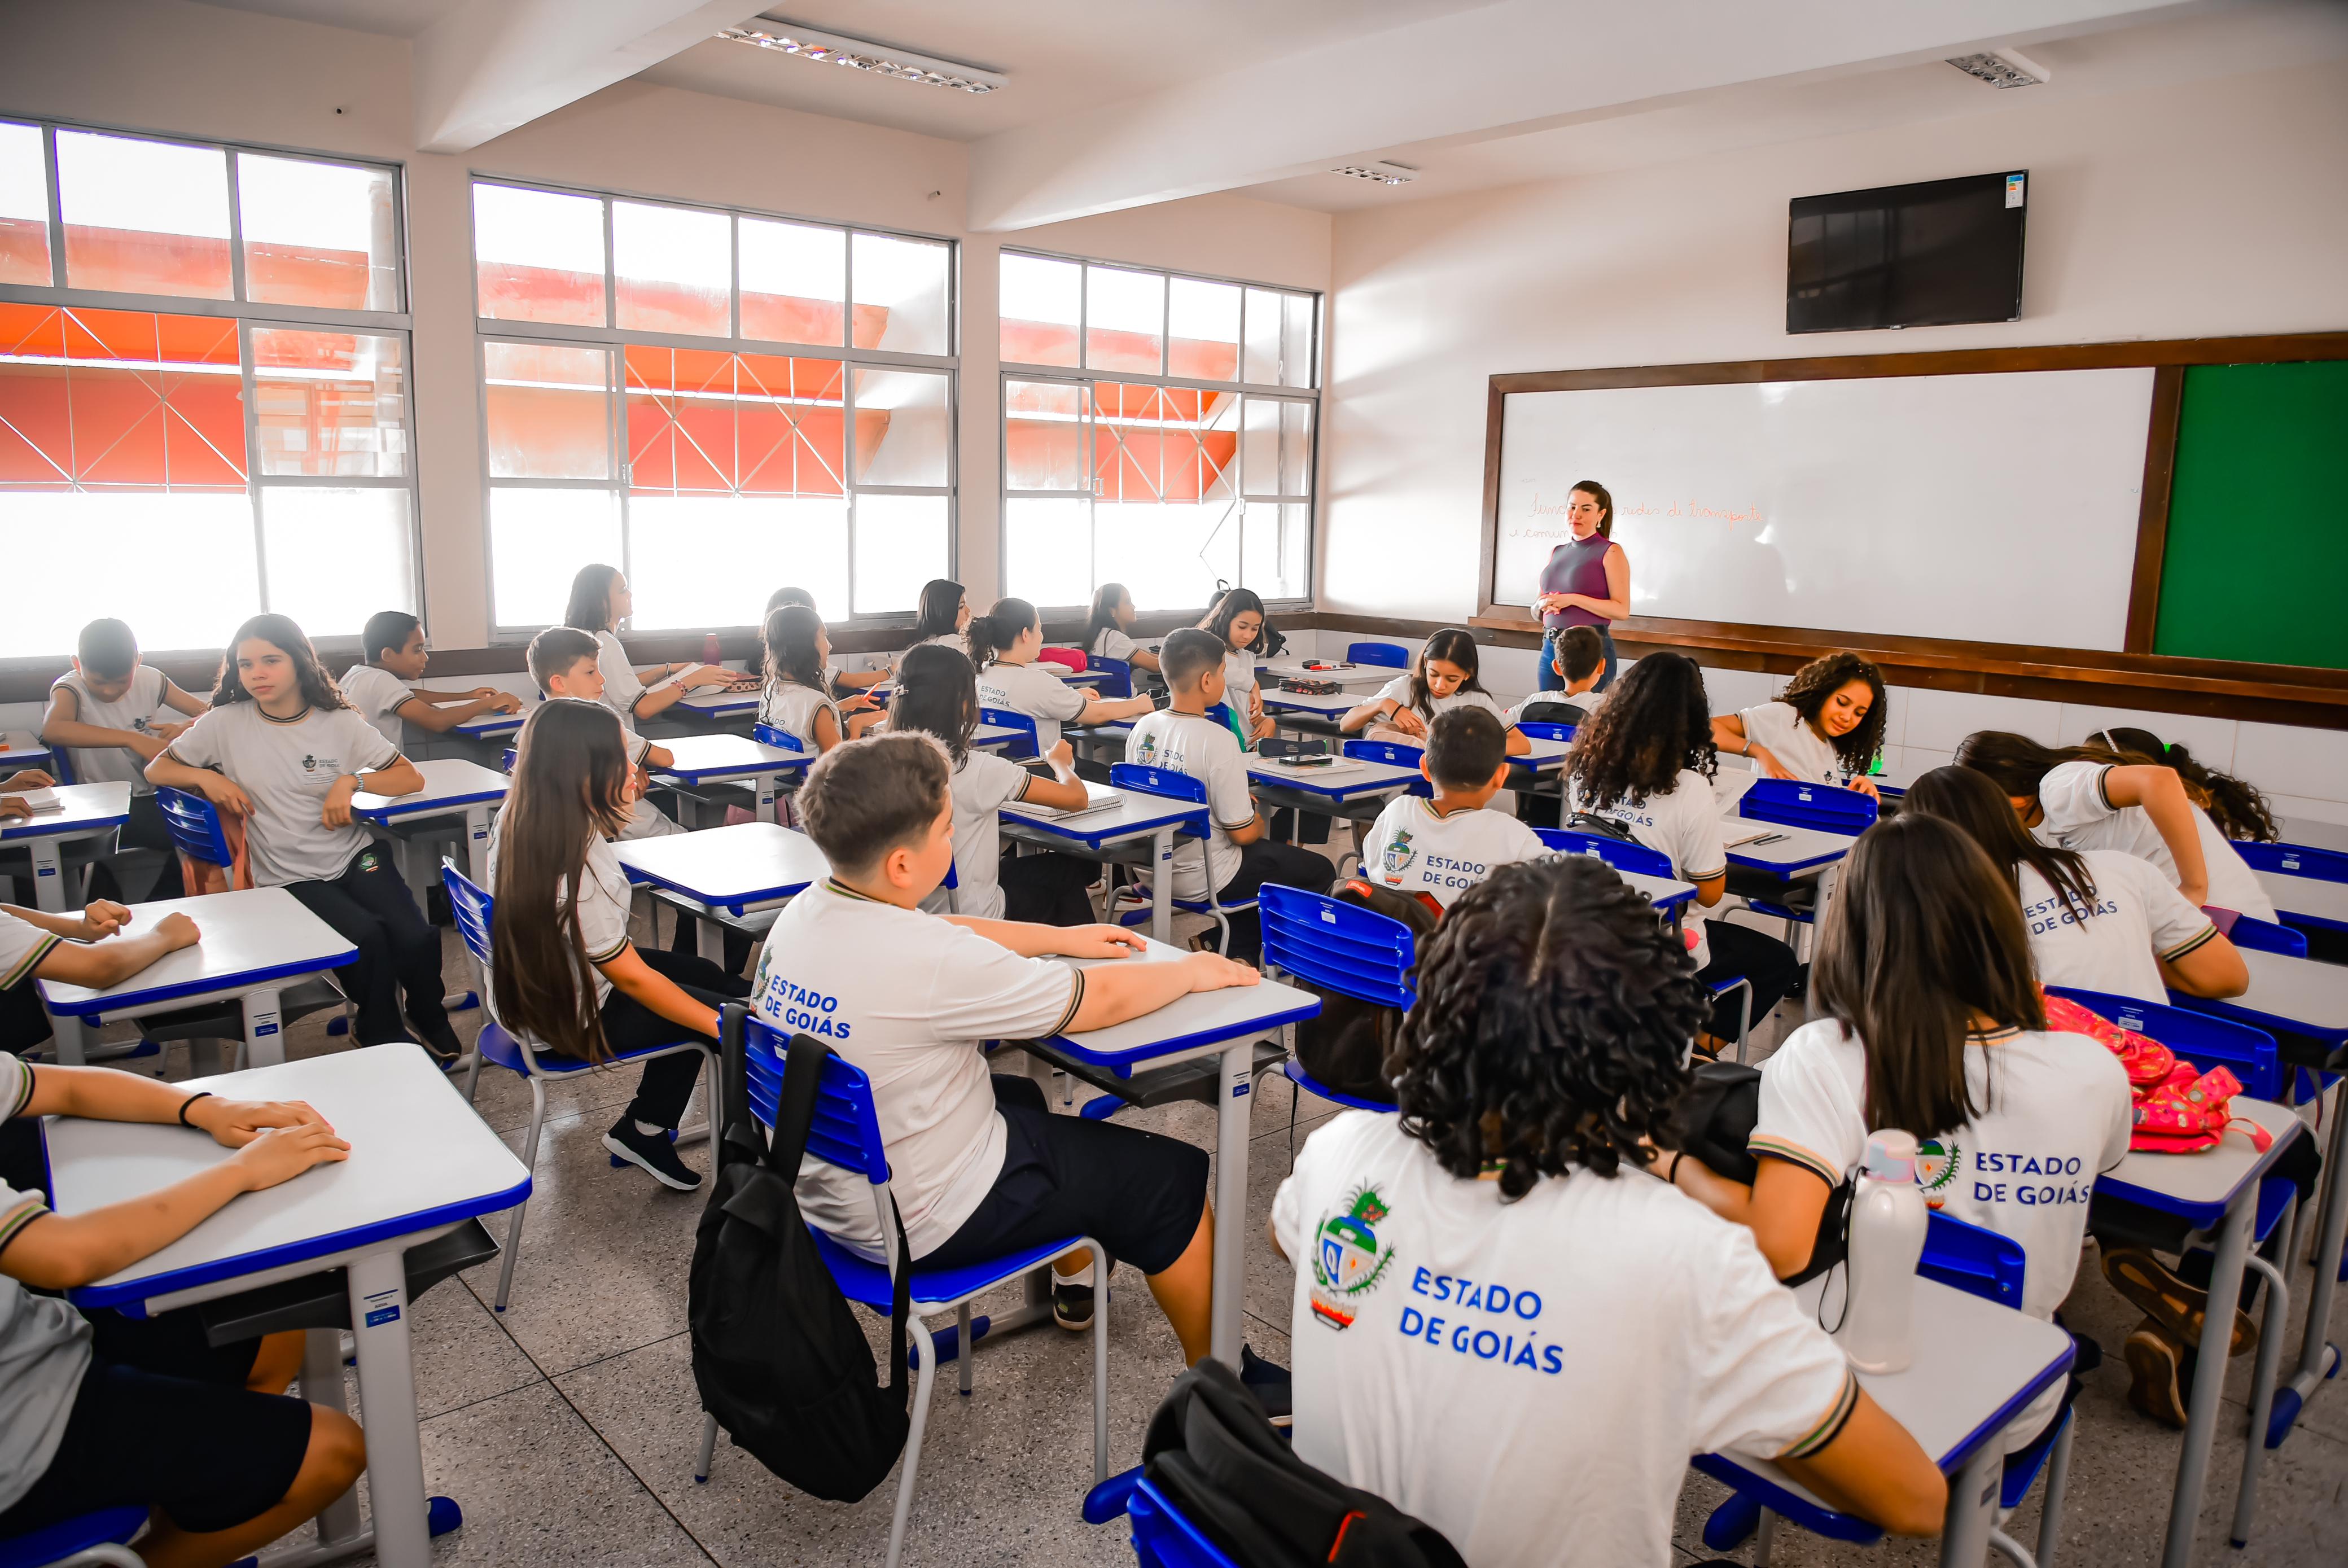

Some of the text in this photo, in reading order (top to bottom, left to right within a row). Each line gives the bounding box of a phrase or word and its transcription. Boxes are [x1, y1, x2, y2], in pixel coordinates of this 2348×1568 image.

[1621, 502, 1659, 516] redes
[981, 685, 1006, 697] ESTADO
[987, 697, 1010, 707] GOIÁS
[768, 716, 785, 725] TADO
[1617, 809, 1653, 827] GOIÁS
[1426, 855, 1485, 874] ESTADO
[1422, 871, 1442, 885] DE
[2031, 899, 2118, 935] DE GOÁS
[770, 975, 838, 1013] ESTADO
[765, 995, 851, 1039] DE GOIÁS
[1975, 1151, 2081, 1176] ESTADO
[1973, 1180, 2090, 1206] DE GOIÁS
[1412, 1266, 1542, 1320] ESTADO
[1399, 1306, 1563, 1374] DE GOIÁS
